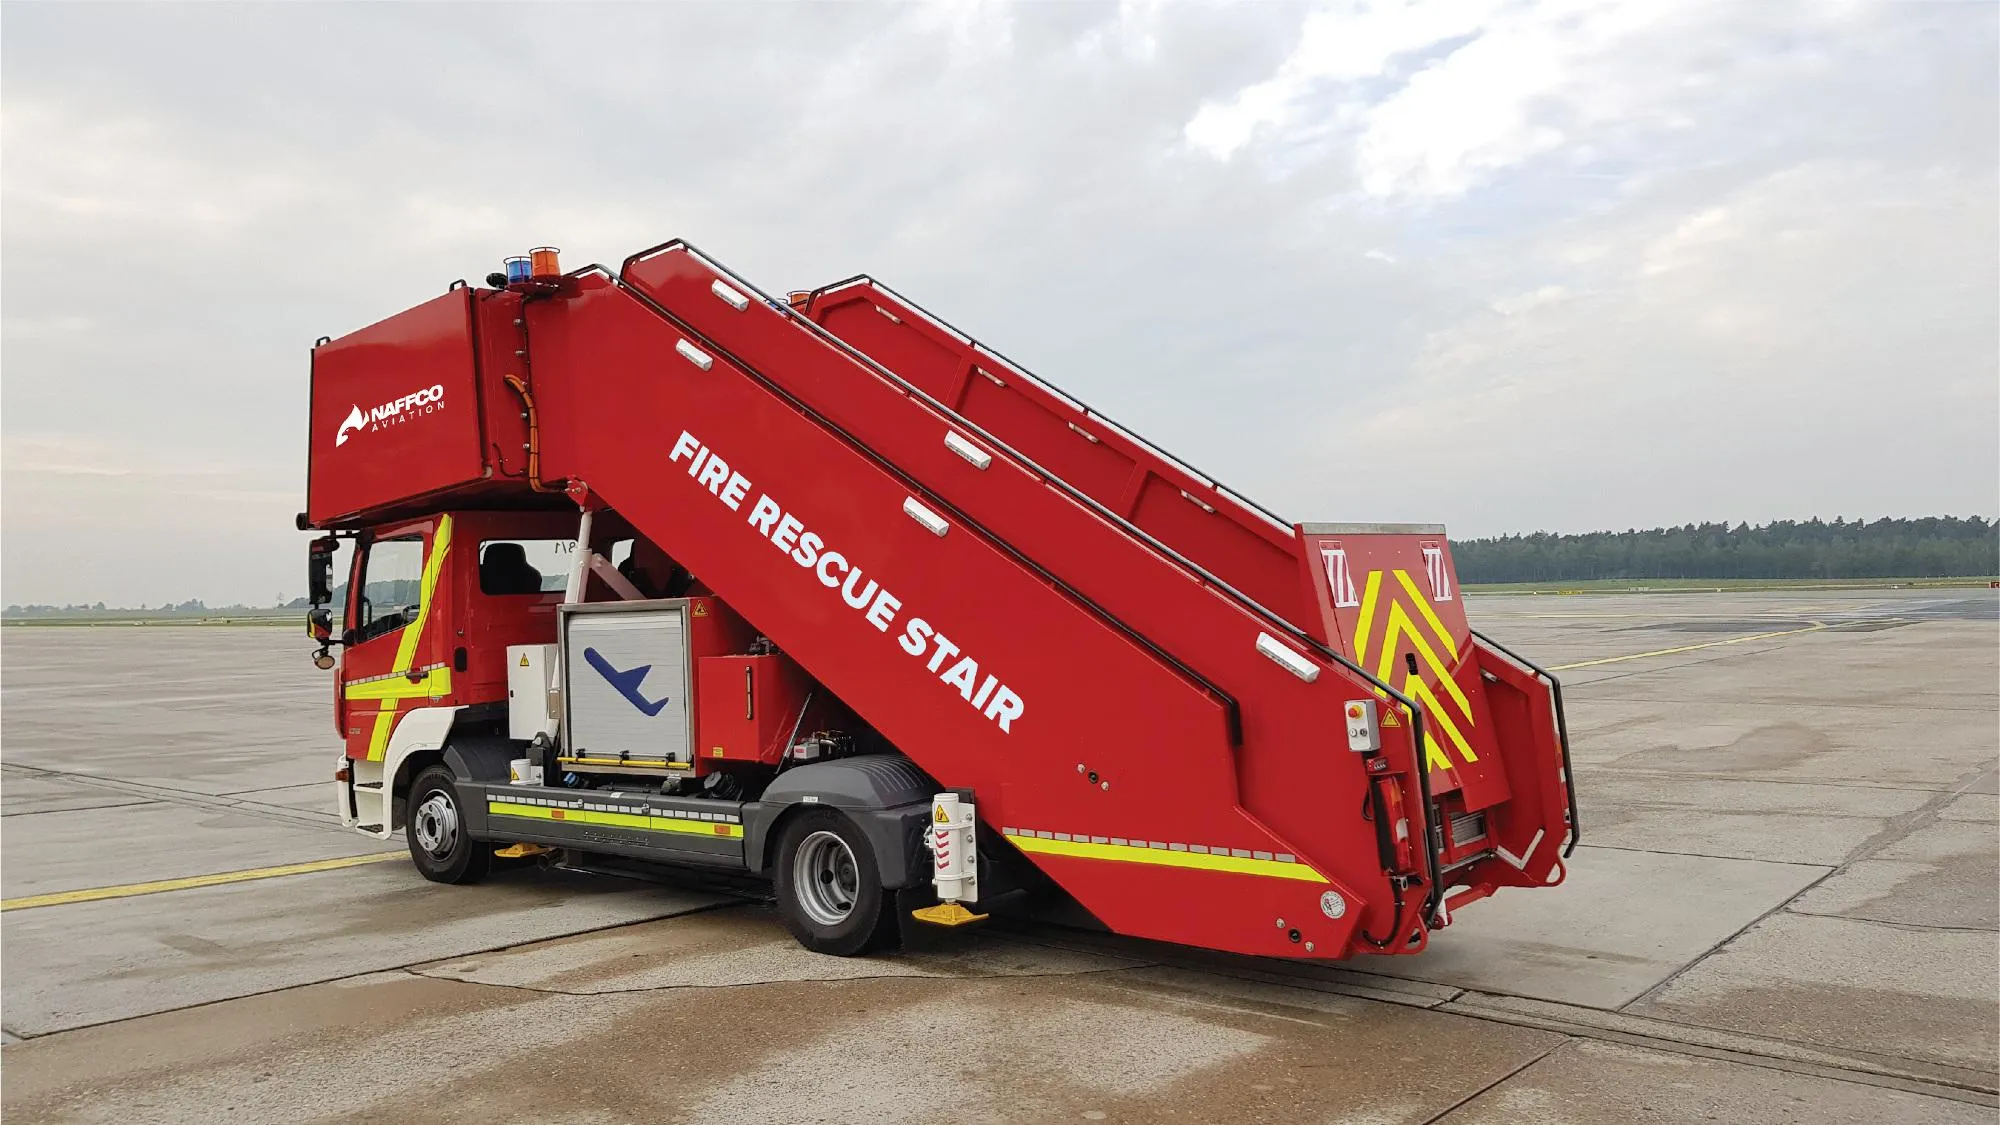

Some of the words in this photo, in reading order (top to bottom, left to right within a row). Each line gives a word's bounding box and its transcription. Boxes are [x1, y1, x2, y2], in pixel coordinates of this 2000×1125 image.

[371, 384, 444, 423] NAFFCO
[371, 400, 445, 433] AVIATION
[668, 429, 753, 512] FIRE
[747, 493, 903, 633] RESCUE
[897, 617, 1025, 735] STAIR
